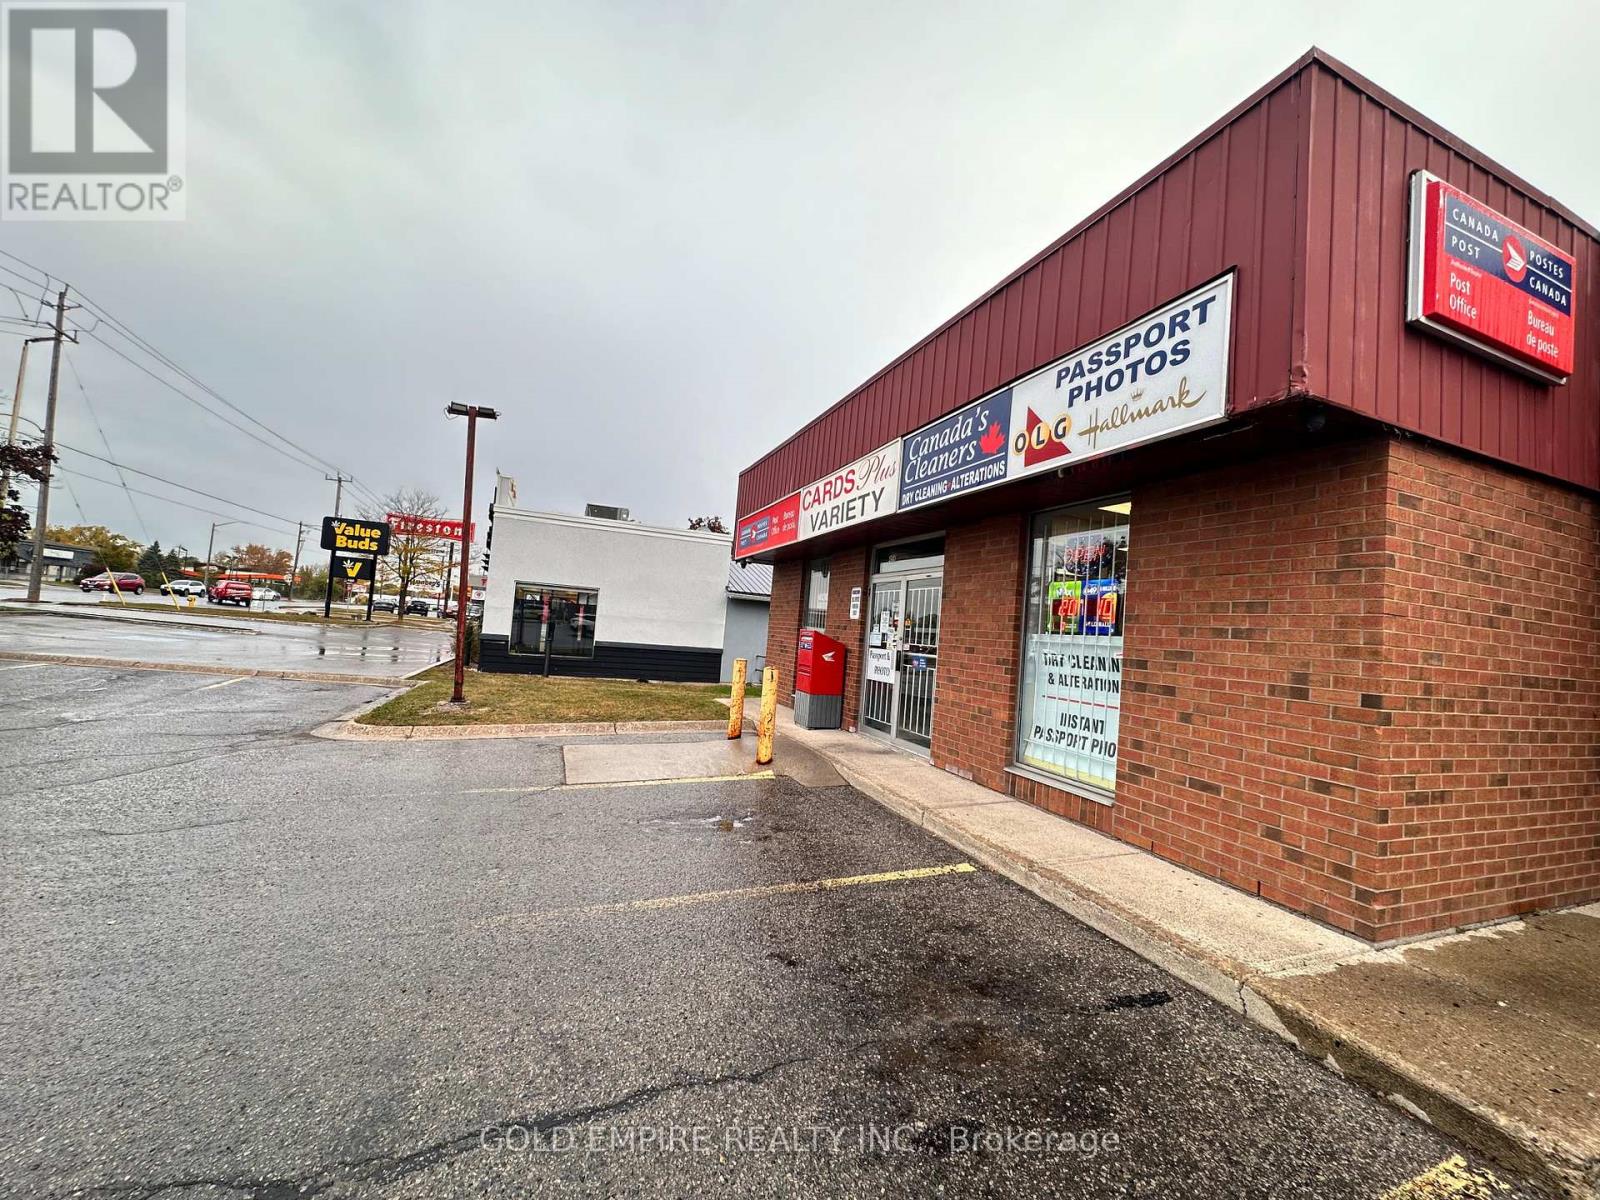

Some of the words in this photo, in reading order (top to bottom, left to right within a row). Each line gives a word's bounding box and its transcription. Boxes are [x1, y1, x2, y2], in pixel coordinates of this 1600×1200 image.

[1452, 208, 1498, 242] CANADA
[1451, 236, 1480, 260] POST
[1529, 250, 1564, 279] POSTES
[1450, 272, 1471, 295] Post
[1529, 276, 1567, 306] CANADA
[1449, 294, 1477, 319] Office
[1527, 310, 1554, 337] Bureau
[1056, 295, 1216, 389] PASSPORT
[1526, 331, 1537, 348] de
[1537, 337, 1559, 358] poste
[1068, 339, 1191, 408] PHOTOS
[1078, 376, 1207, 449] Hallmark
[909, 407, 989, 460] Canada's
[1014, 418, 1067, 453] OLG
[905, 440, 977, 483] Cleaners
[802, 469, 856, 511] CARDS
[857, 454, 896, 491] Plus
[902, 491, 915, 506] DRY
[915, 480, 947, 501] CLEANING
[951, 461, 1006, 491] ALTERATIONS
[810, 487, 886, 532] VARIETY
[334, 522, 381, 538] Value
[389, 517, 463, 536] Fireston
[335, 535, 379, 551] Buds
[1048, 672, 1055, 685] &
